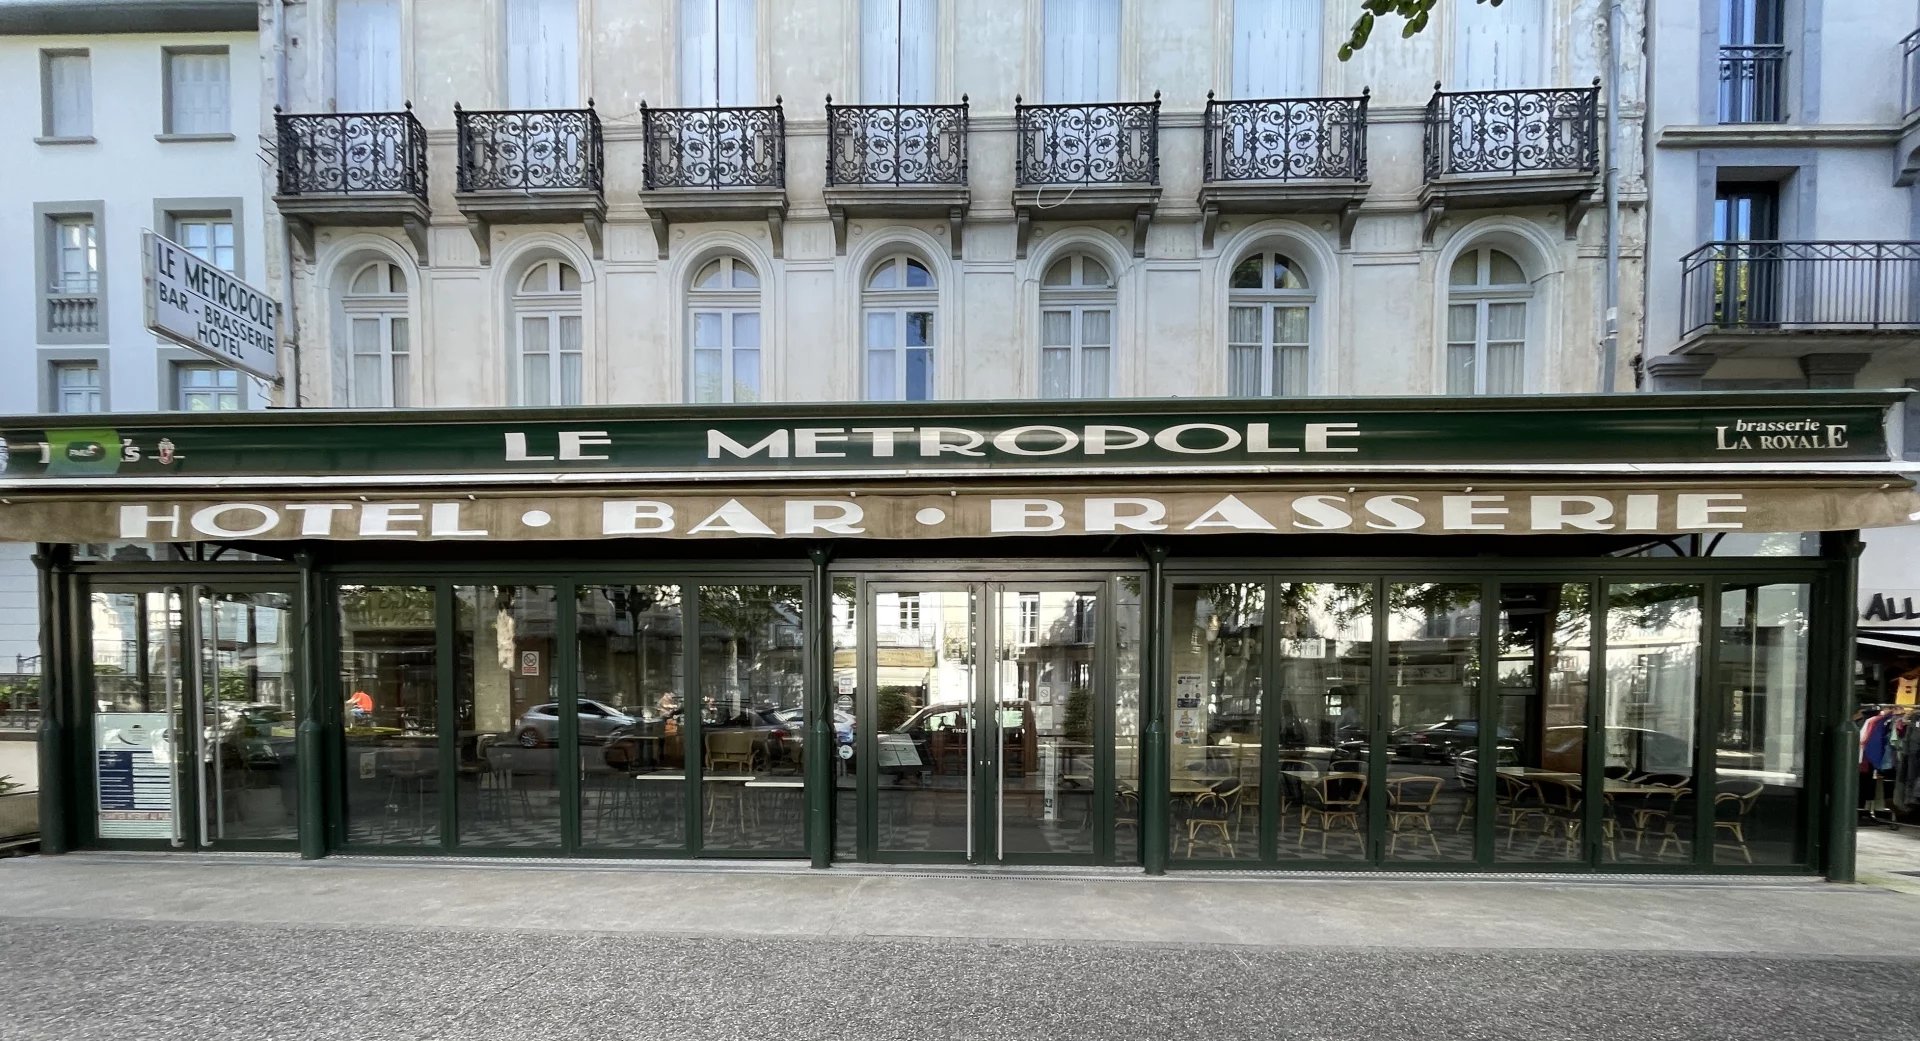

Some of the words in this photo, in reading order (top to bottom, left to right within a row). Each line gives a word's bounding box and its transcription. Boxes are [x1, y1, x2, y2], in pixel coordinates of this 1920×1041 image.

[157, 242, 176, 280] LE
[184, 256, 274, 331] METROPOLE
[159, 281, 190, 314] BAR
[204, 304, 275, 355] BRASSERIE
[196, 321, 244, 360] HOTEL
[504, 431, 612, 461] LE
[706, 422, 1361, 459] METROPOLE
[1715, 425, 1753, 450] LA
[1760, 424, 1849, 449] ROYALE
[1735, 418, 1820, 432] brasserie
[119, 502, 489, 541] HOTEL
[602, 498, 866, 537] BAR
[990, 493, 1747, 536] BRASSERIE
[1864, 592, 1920, 622] ALL
